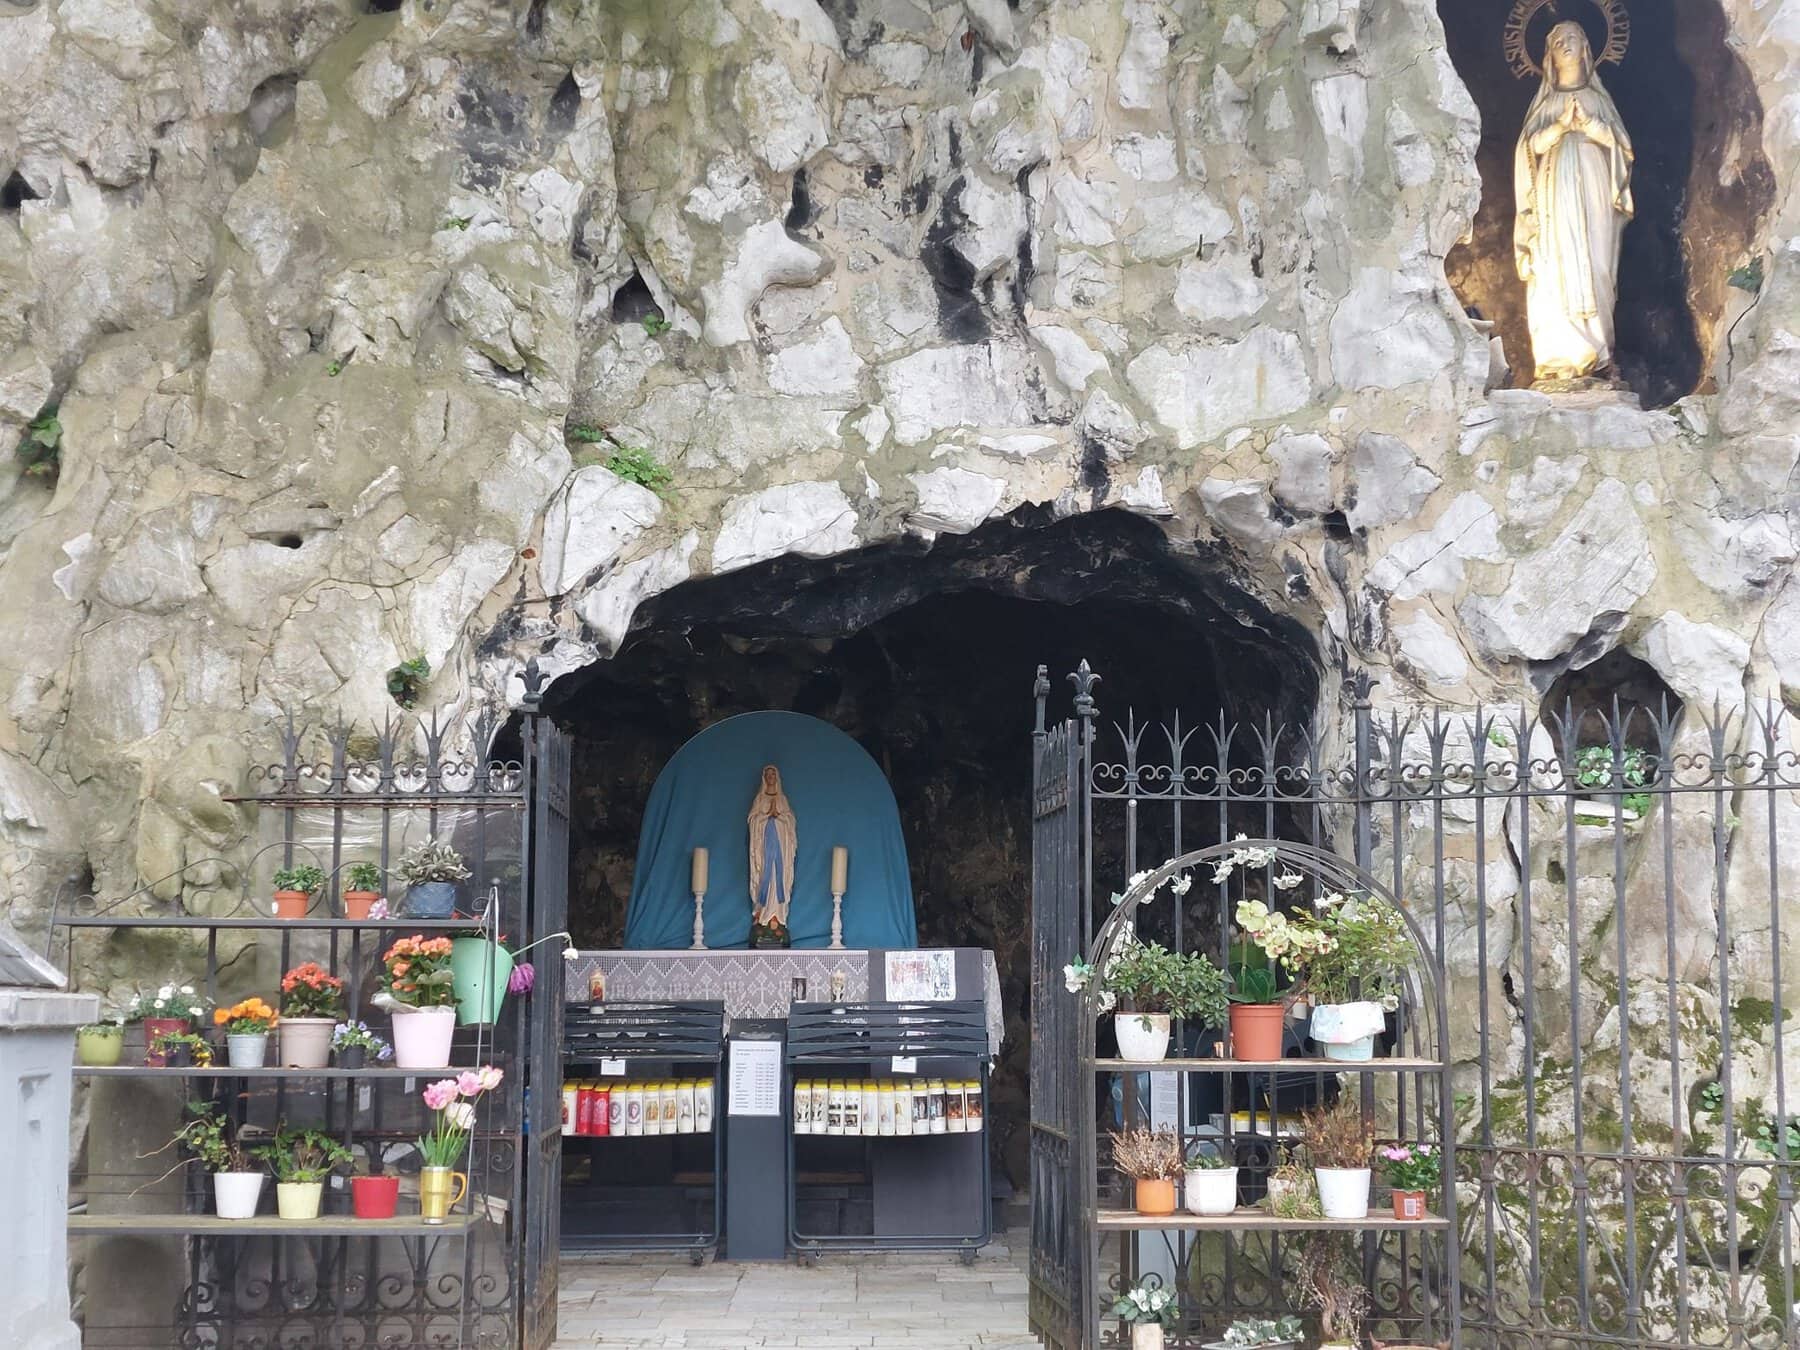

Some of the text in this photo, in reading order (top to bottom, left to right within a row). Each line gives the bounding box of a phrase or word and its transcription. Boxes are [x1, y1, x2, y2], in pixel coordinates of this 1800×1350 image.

[1503, 30, 1522, 63] SUIS
[668, 982, 690, 998] IHS
[723, 981, 744, 996] IHS
